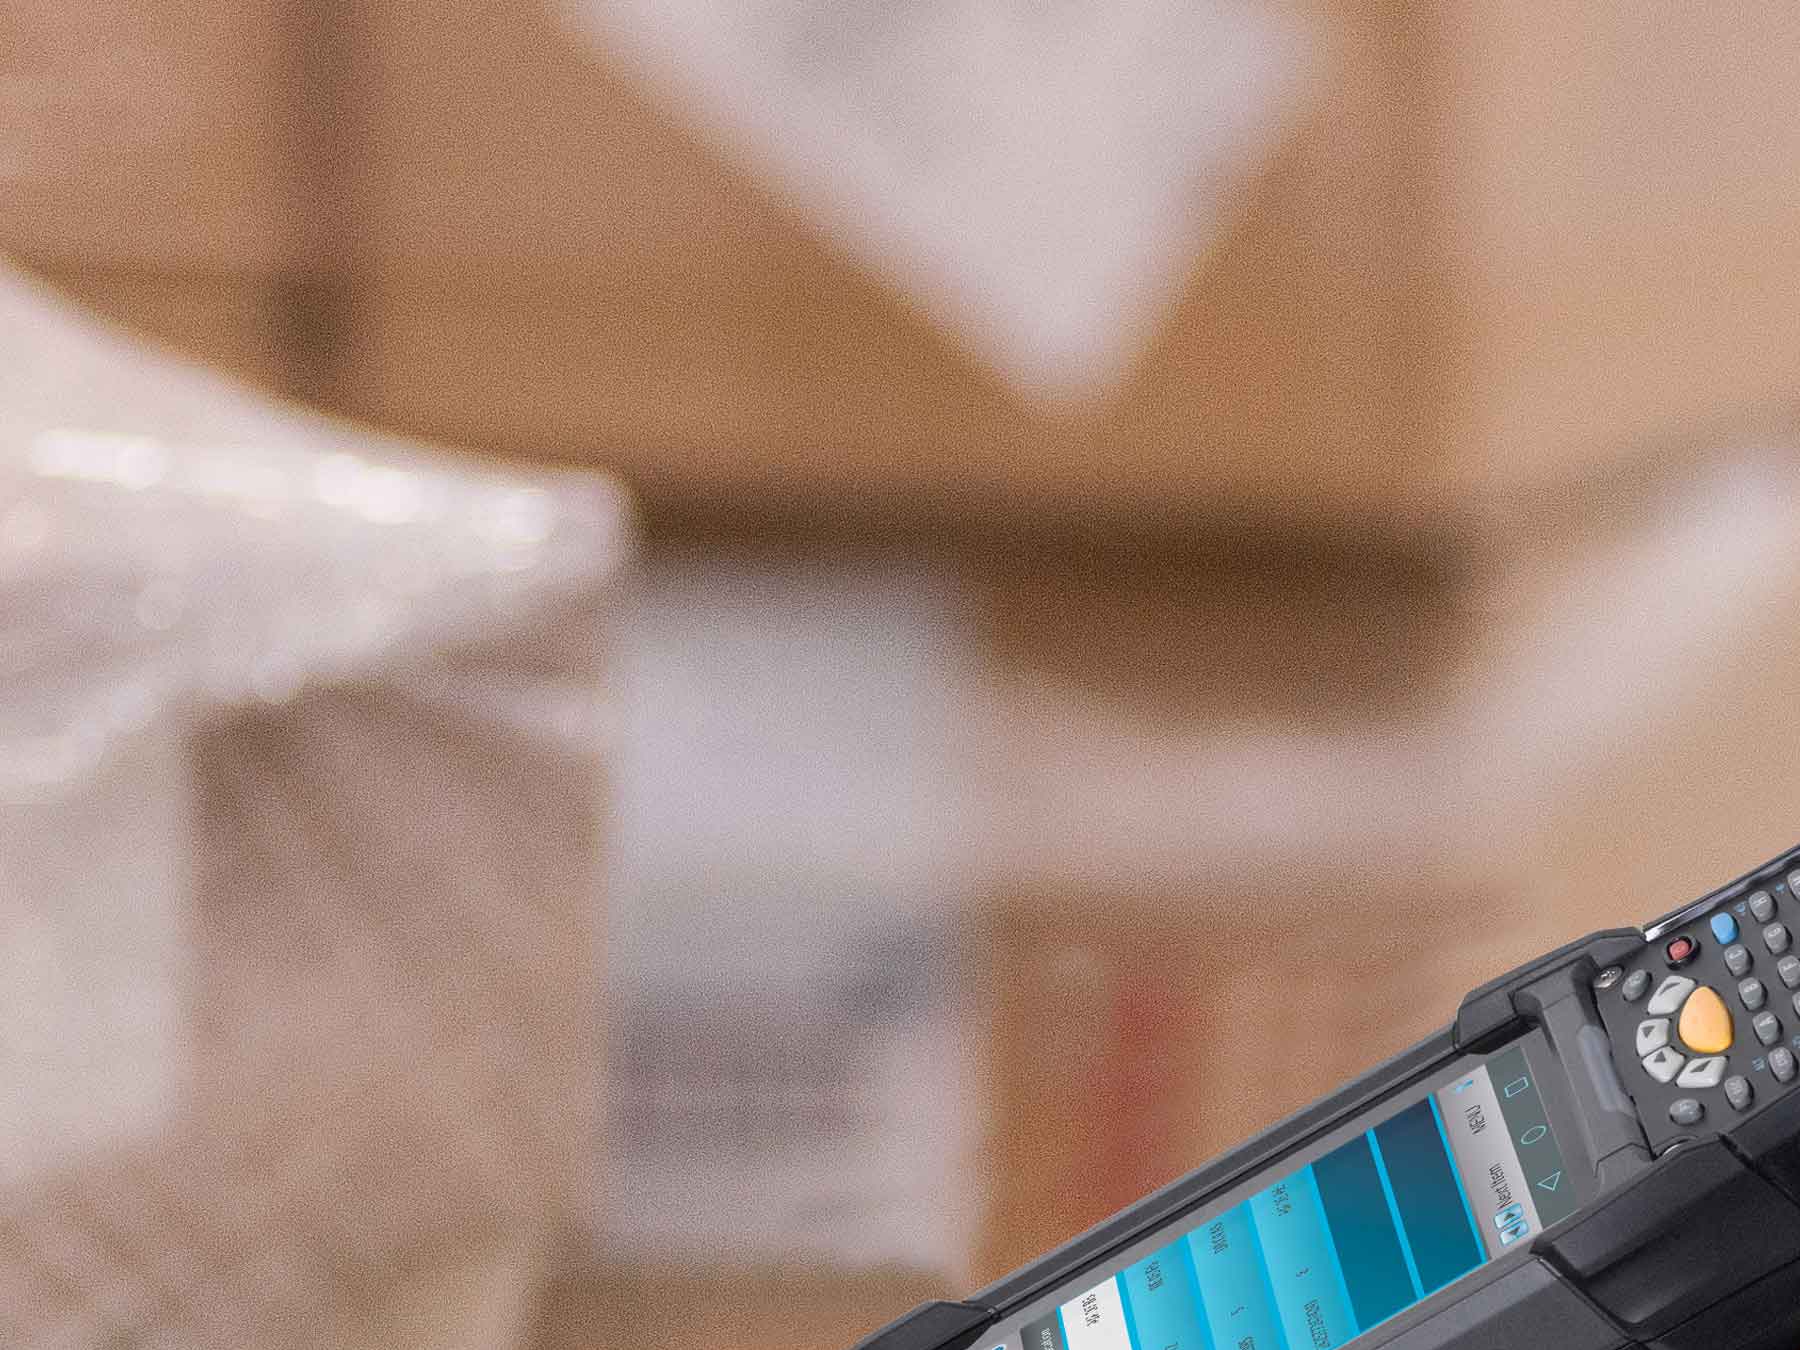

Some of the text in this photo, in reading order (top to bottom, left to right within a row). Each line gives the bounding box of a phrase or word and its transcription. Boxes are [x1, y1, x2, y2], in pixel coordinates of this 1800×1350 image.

[1464, 1104, 1488, 1136] MENU
[1489, 1163, 1513, 1210] Next Item
